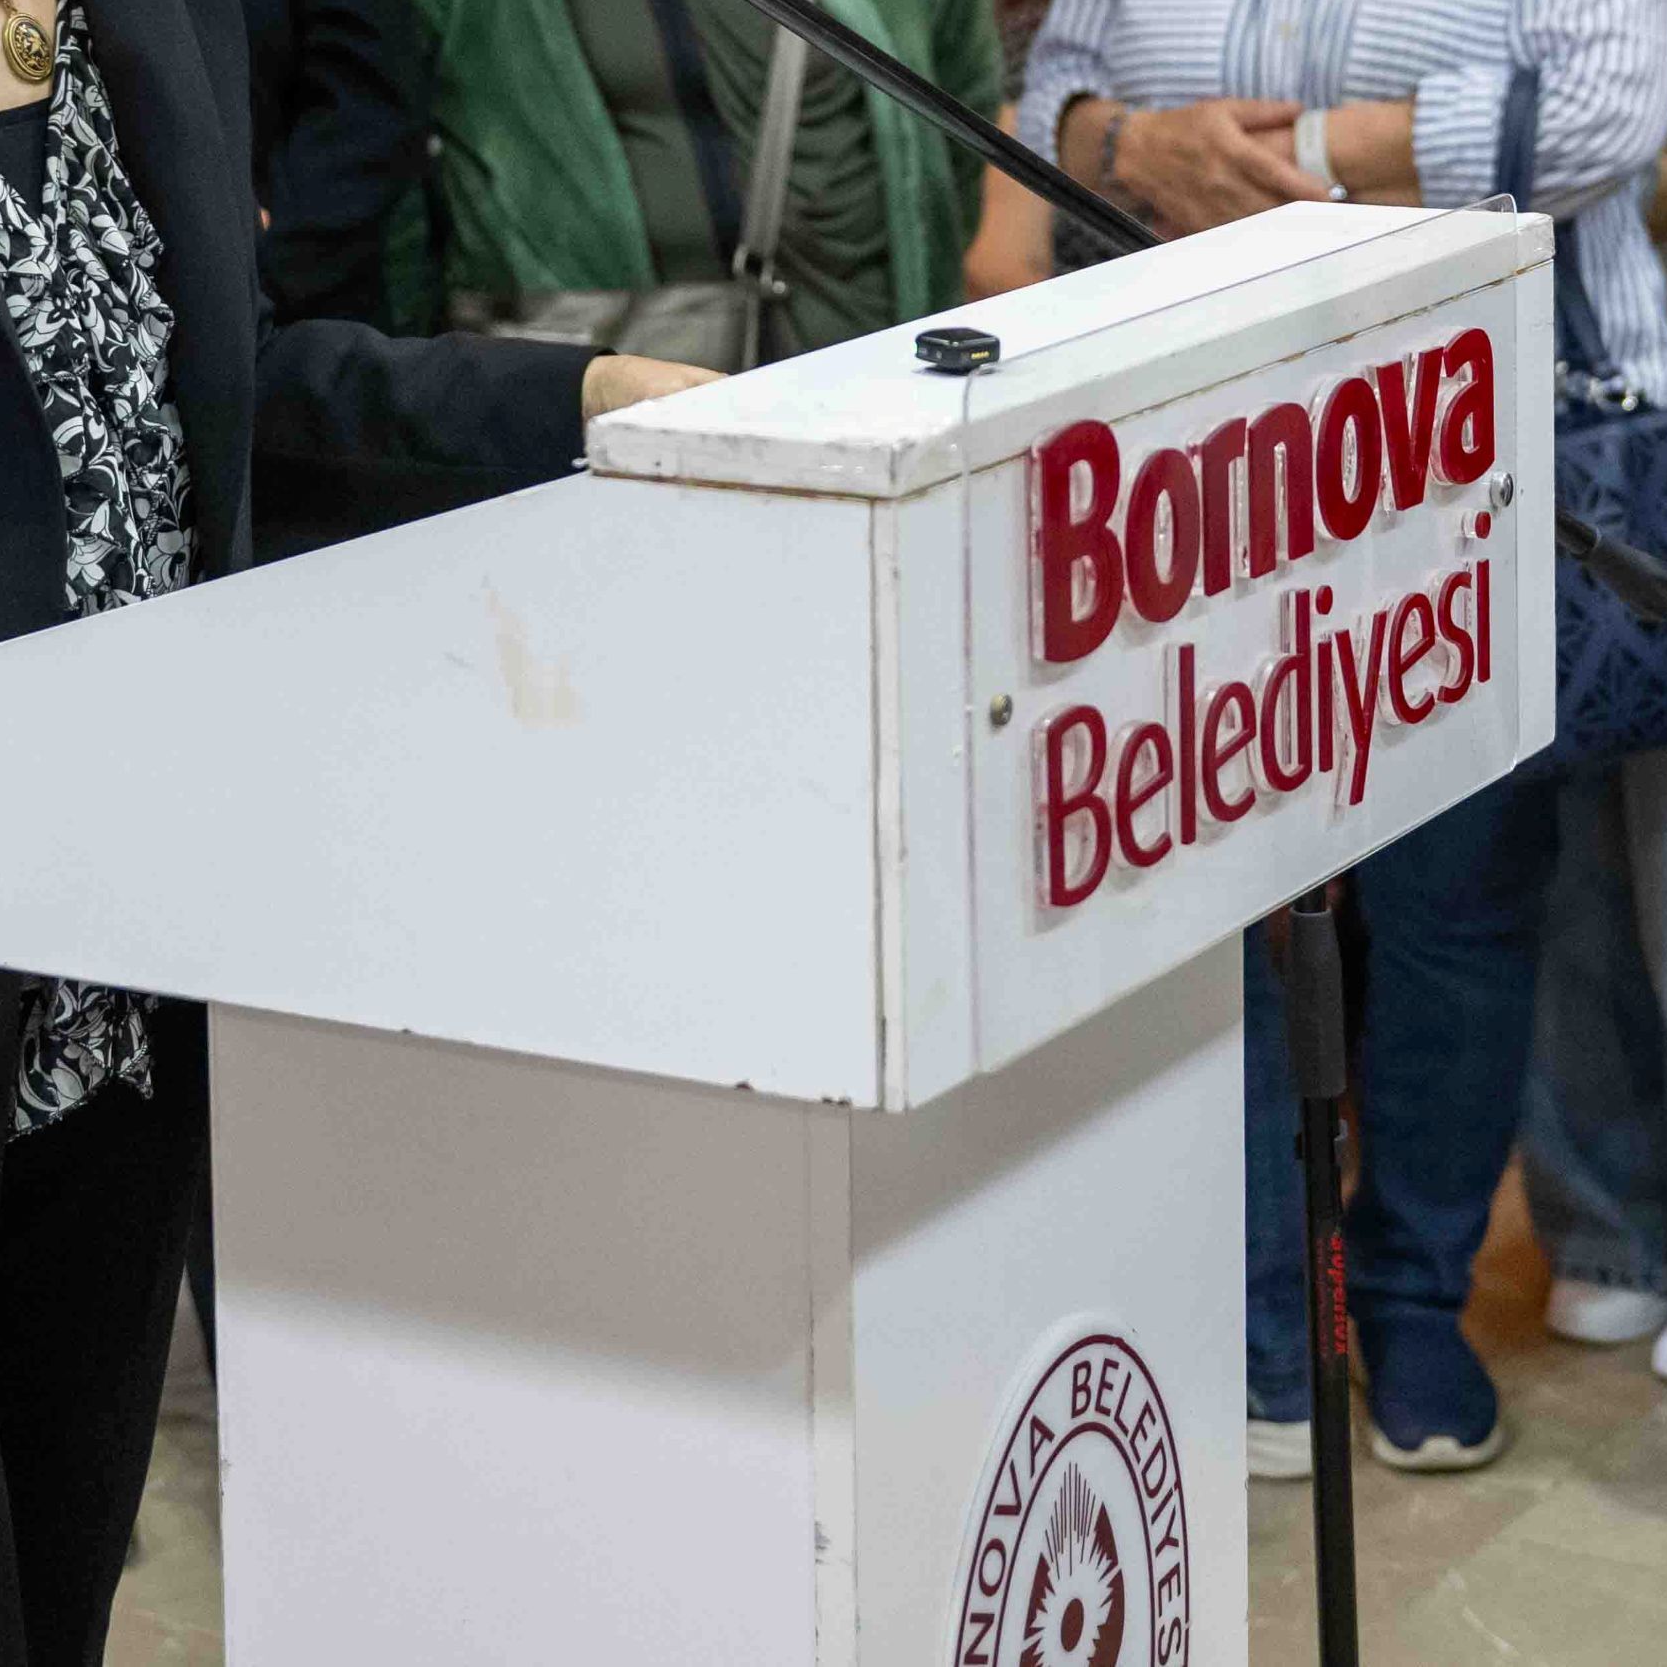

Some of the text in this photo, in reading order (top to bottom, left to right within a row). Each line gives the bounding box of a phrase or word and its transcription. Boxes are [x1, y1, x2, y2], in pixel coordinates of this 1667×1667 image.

[1038, 327, 1495, 663] Bornova
[1045, 511, 1492, 907] Belediyesi
[963, 1357, 1182, 1667] NOVA BELEDİYES
